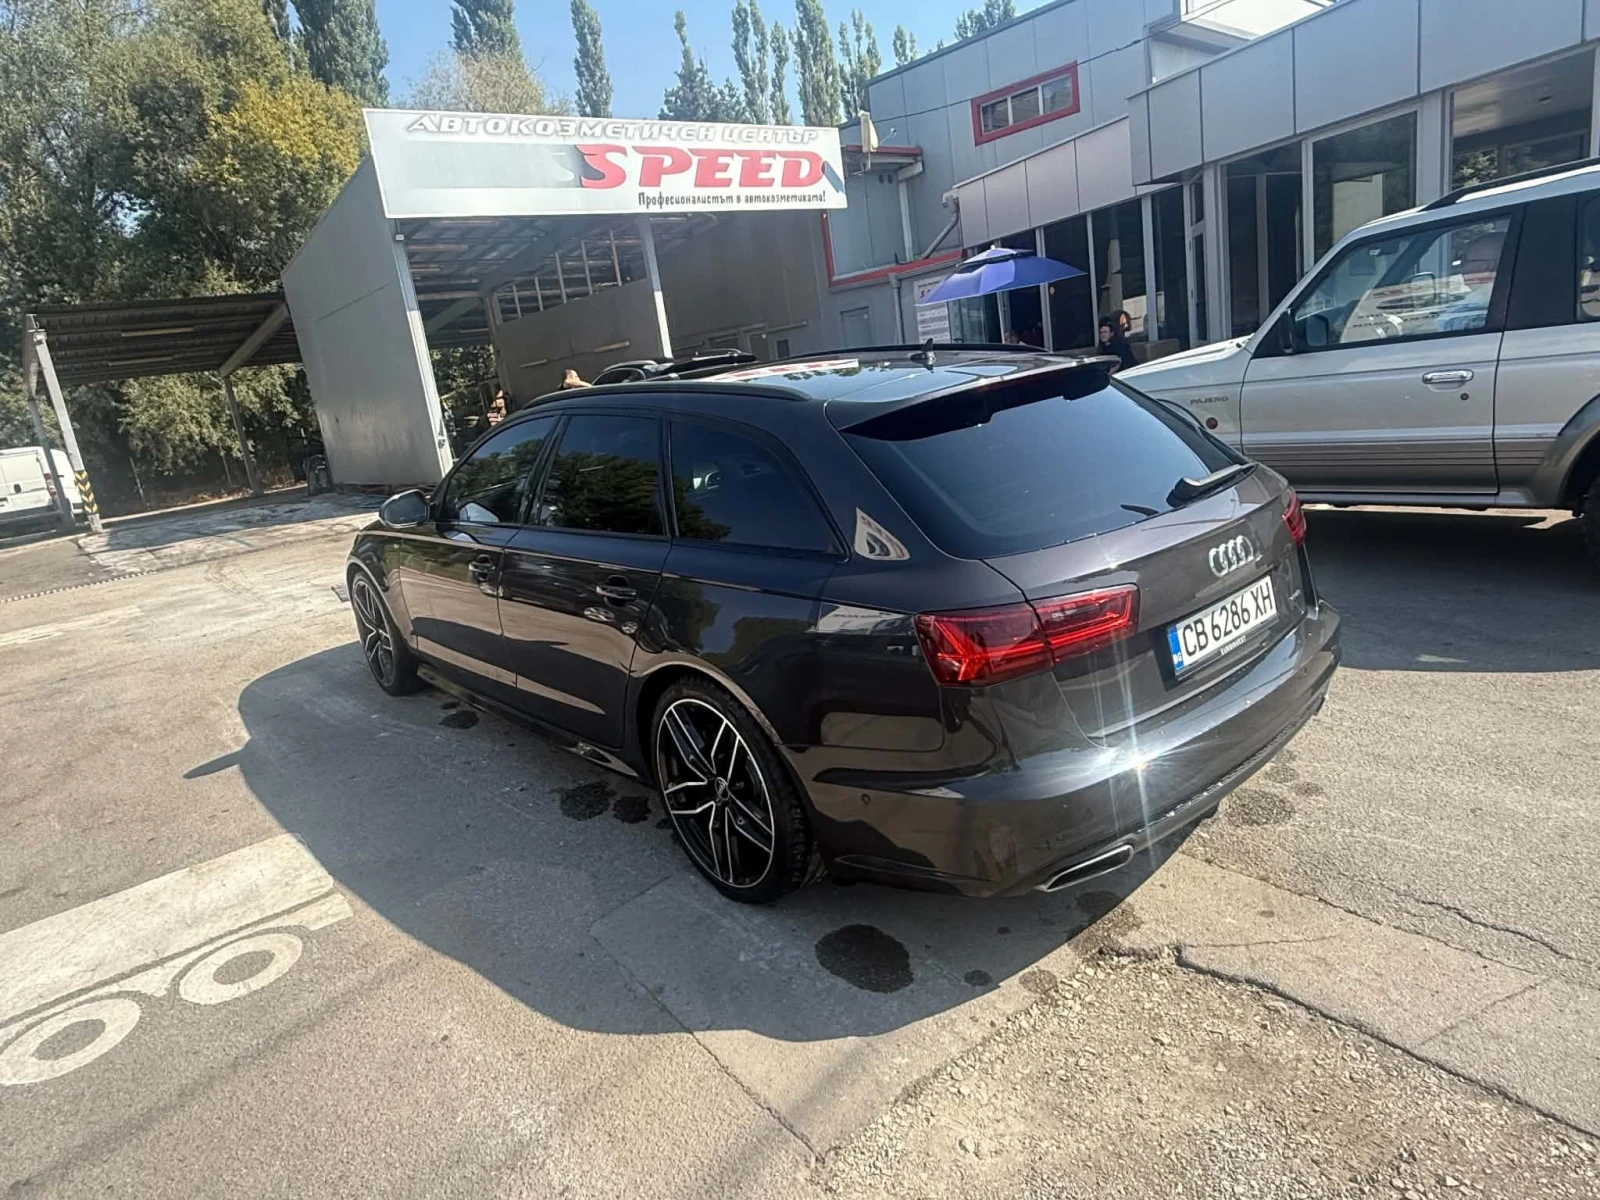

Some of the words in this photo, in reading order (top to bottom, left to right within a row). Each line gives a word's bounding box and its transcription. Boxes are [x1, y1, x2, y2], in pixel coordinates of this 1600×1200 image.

[407, 114, 716, 141] АВТОКОЗМЕТИЧЕН
[722, 126, 820, 145] ЦЕНТЪР
[574, 143, 825, 189] SPEED
[638, 191, 734, 209] Професионалистът
[736, 194, 741, 204] в
[744, 190, 826, 205] автокозметиката!
[1190, 395, 1229, 405] PAJERO
[1182, 619, 1209, 657] CB
[1211, 595, 1250, 641] 6286
[1250, 581, 1273, 620] XH
